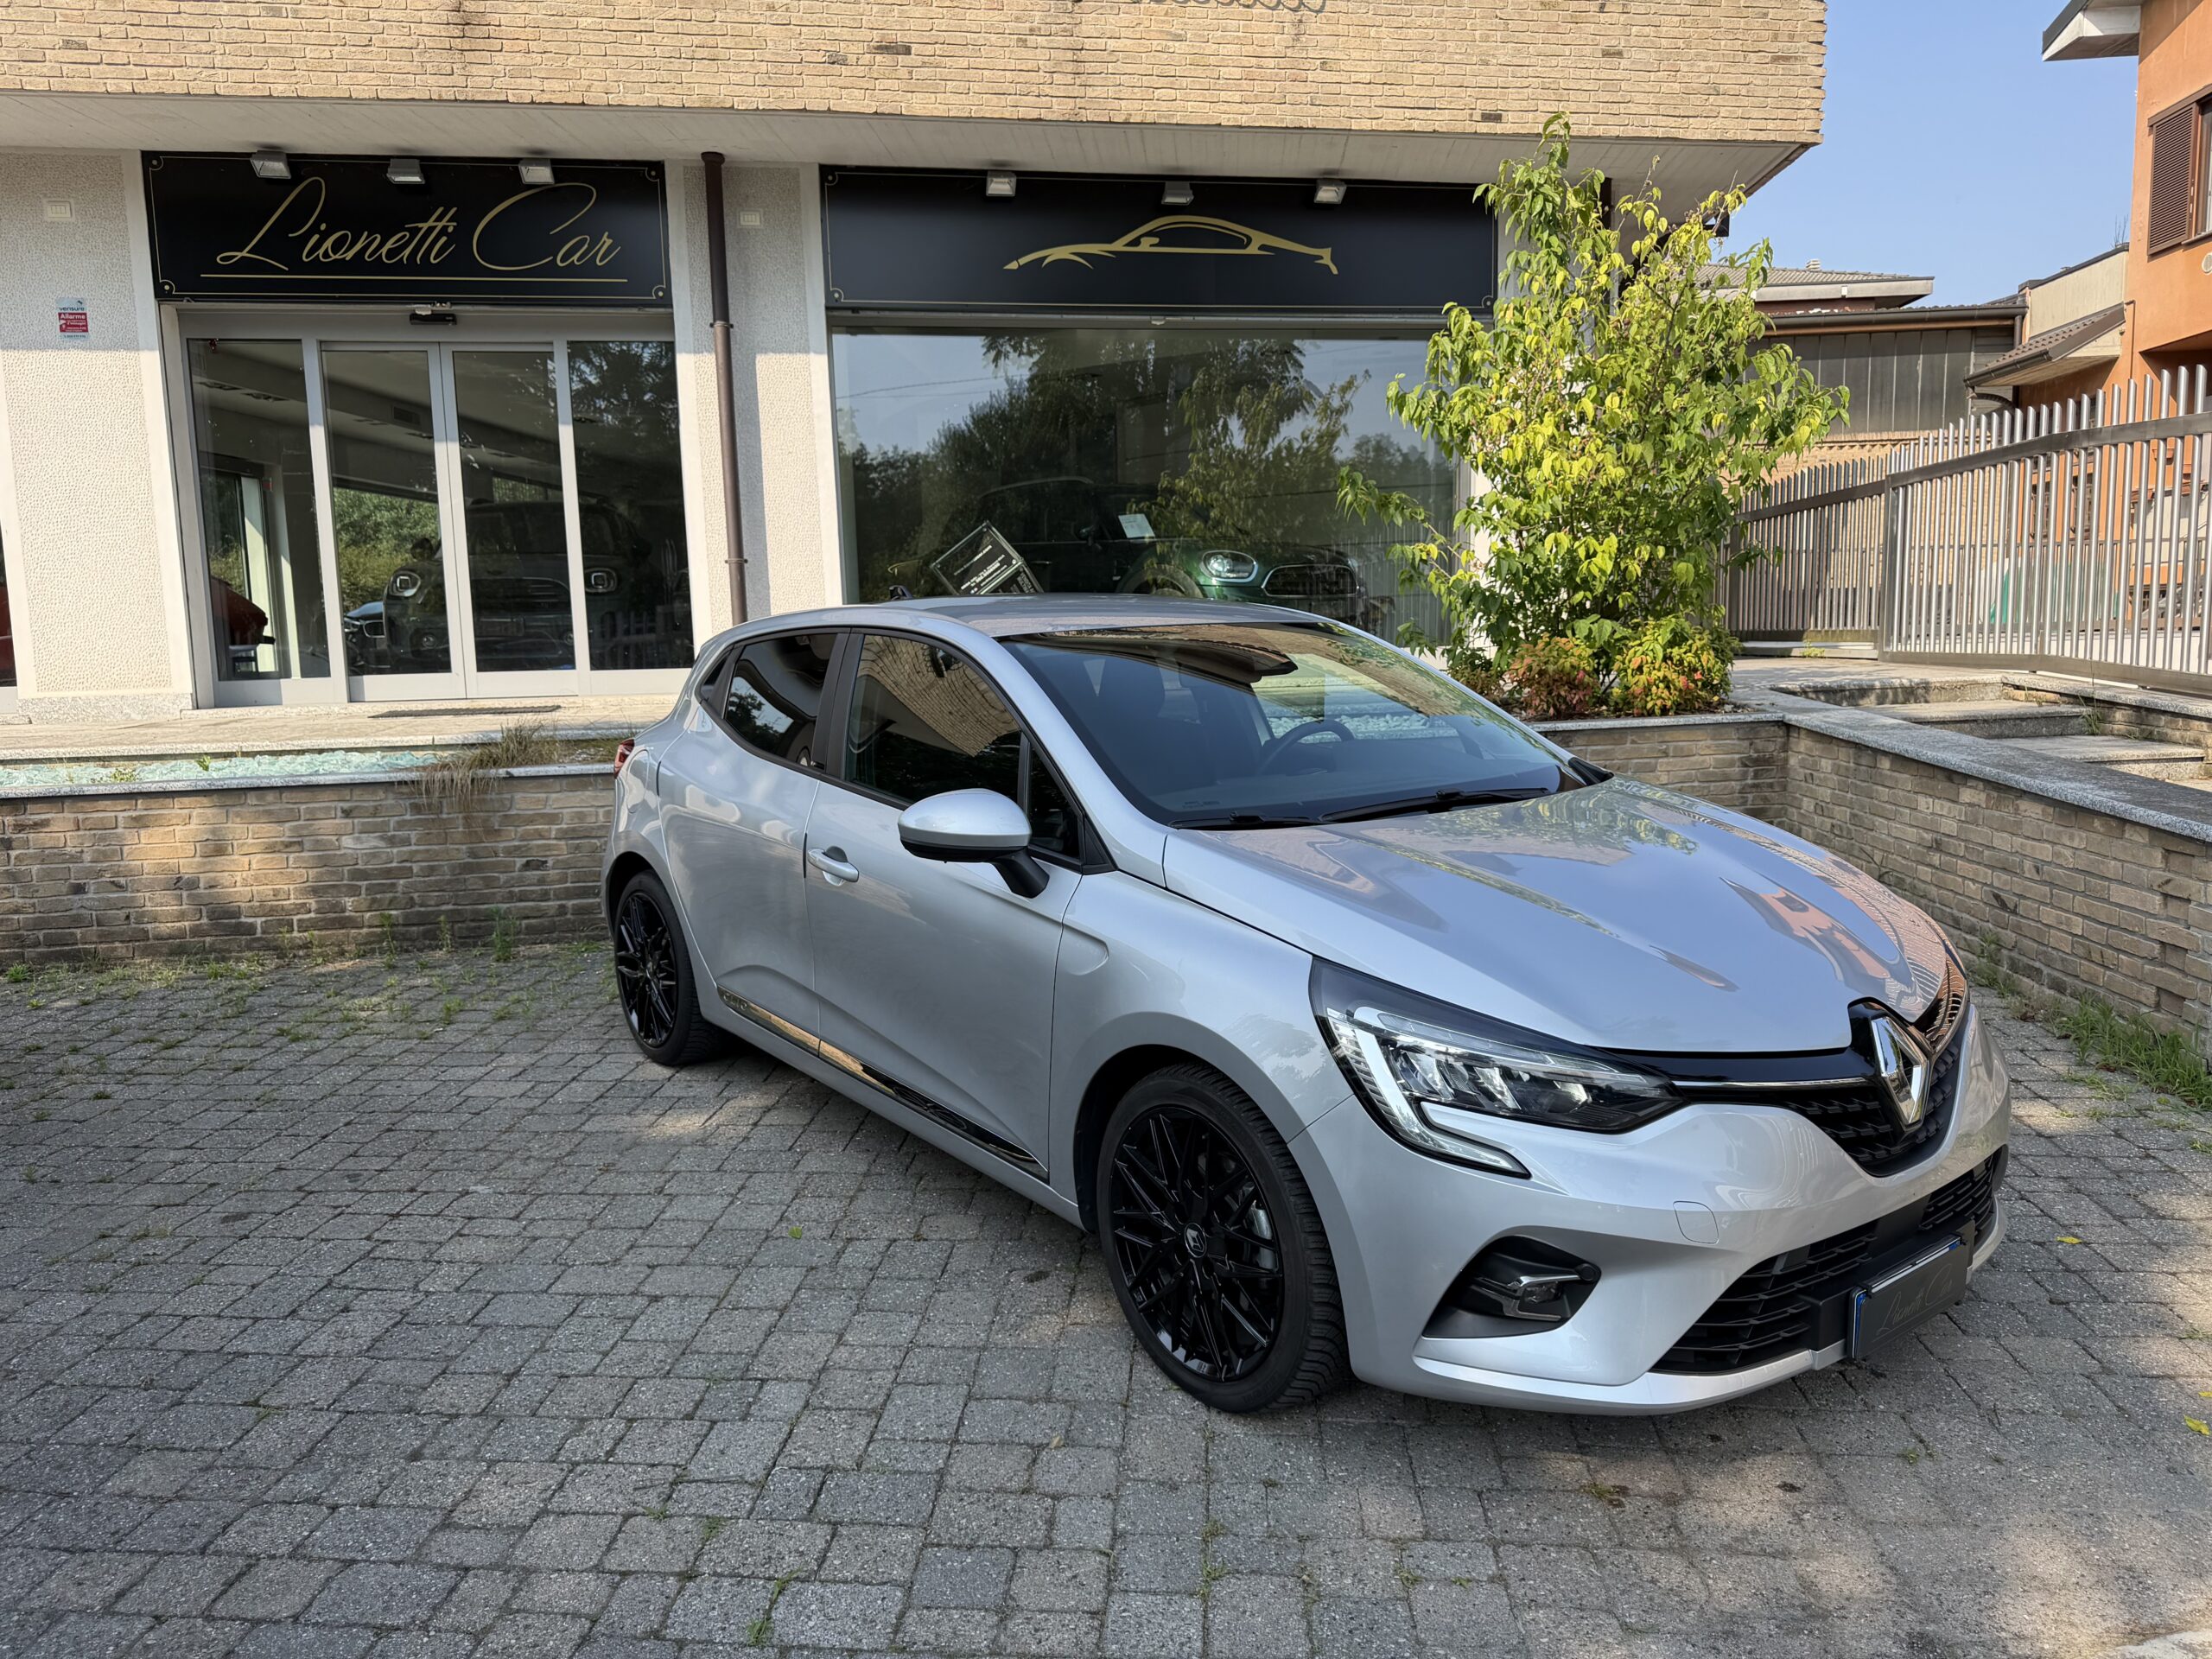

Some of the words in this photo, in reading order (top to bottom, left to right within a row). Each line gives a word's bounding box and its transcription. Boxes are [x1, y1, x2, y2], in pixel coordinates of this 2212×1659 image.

[216, 176, 457, 271] Lionetti
[473, 182, 621, 271] Car
[723, 992, 747, 1011] CLIO
